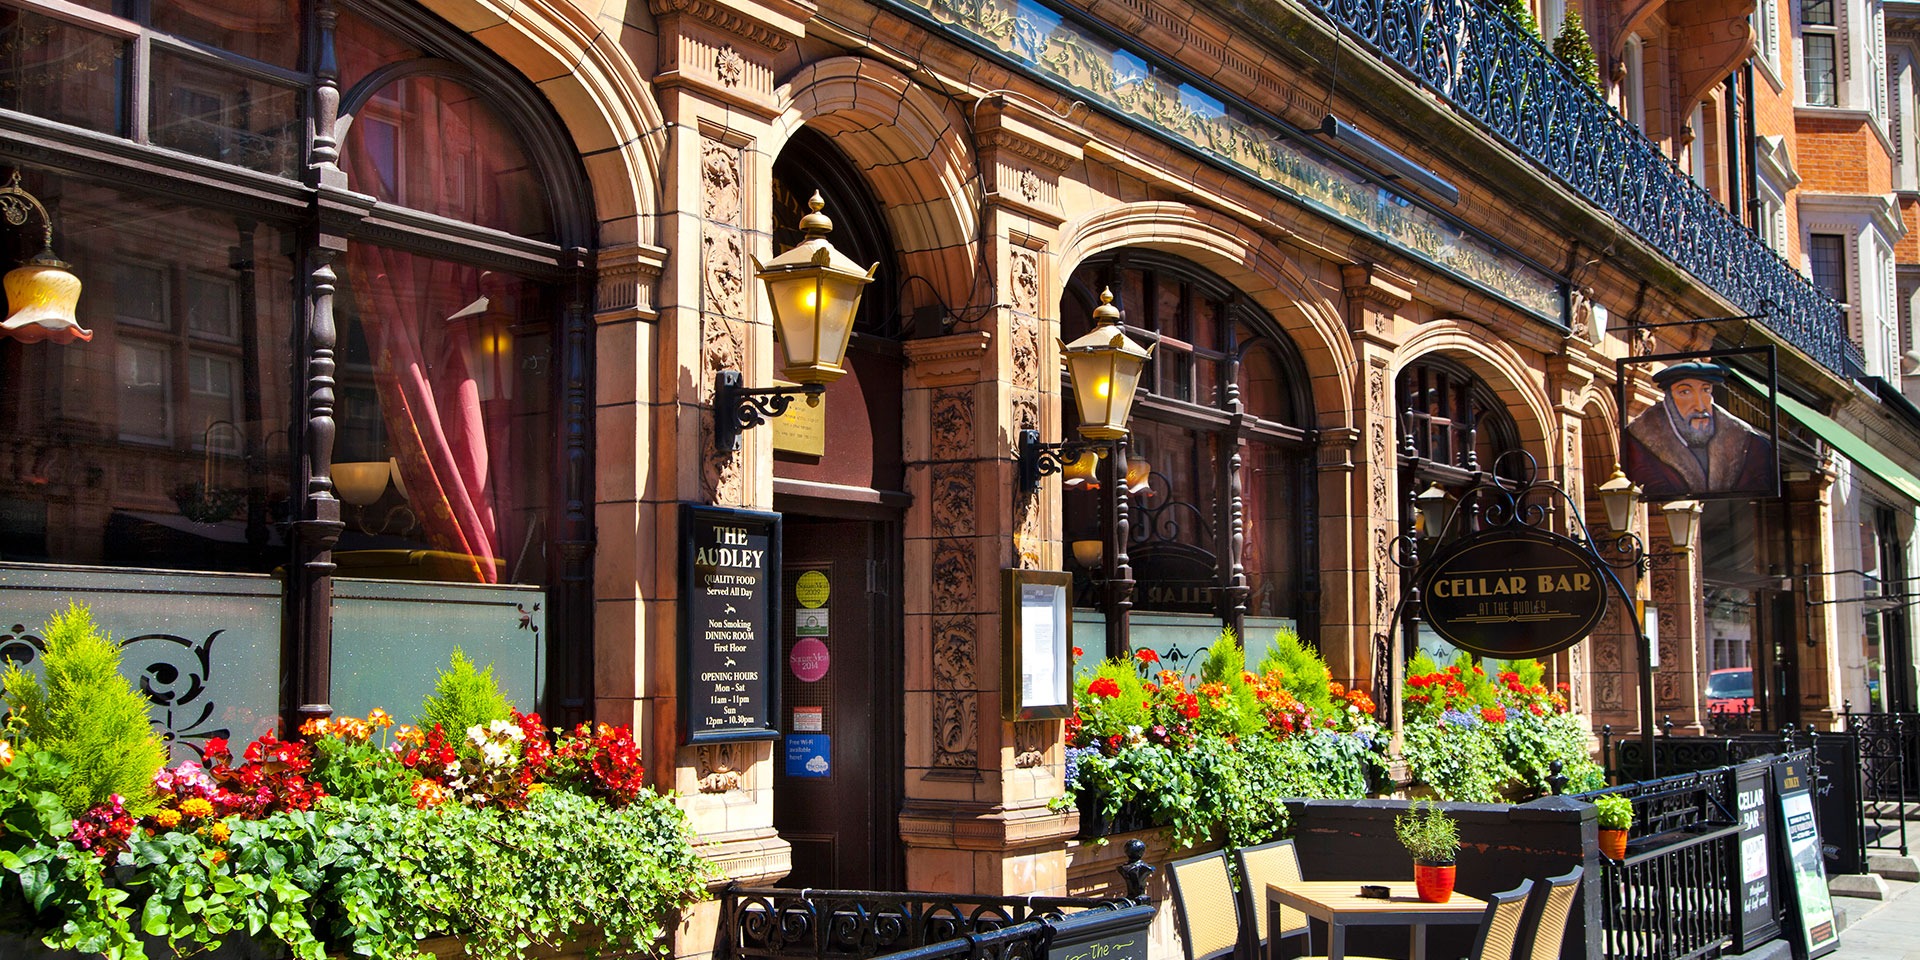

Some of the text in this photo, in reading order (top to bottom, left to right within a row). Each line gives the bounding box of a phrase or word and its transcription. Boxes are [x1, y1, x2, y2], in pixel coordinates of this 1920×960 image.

[713, 526, 748, 545] THE
[696, 547, 764, 568] AUDLEY
[704, 575, 756, 585] QUALITY FOOD
[1434, 573, 1592, 598] CELLAR BAR
[706, 587, 753, 600] Served All Day
[1479, 600, 1547, 615] AT THE AUDLEY
[708, 620, 752, 632] Non Smoking
[705, 631, 754, 640] DINING ROOM
[713, 643, 747, 652] First Floor
[802, 661, 819, 671] 2014
[701, 671, 758, 682] OPENING HOURS
[714, 683, 730, 692] Mon
[735, 683, 745, 692] Sat
[711, 695, 727, 704] 11am
[732, 695, 750, 706] 11pm
[723, 706, 736, 714] Sun
[705, 716, 723, 728] 12pm
[728, 715, 754, 726] 10.30pm
[1738, 788, 1764, 811] CELLAR
[1744, 810, 1760, 831] BAR
[1090, 943, 1109, 959] The
